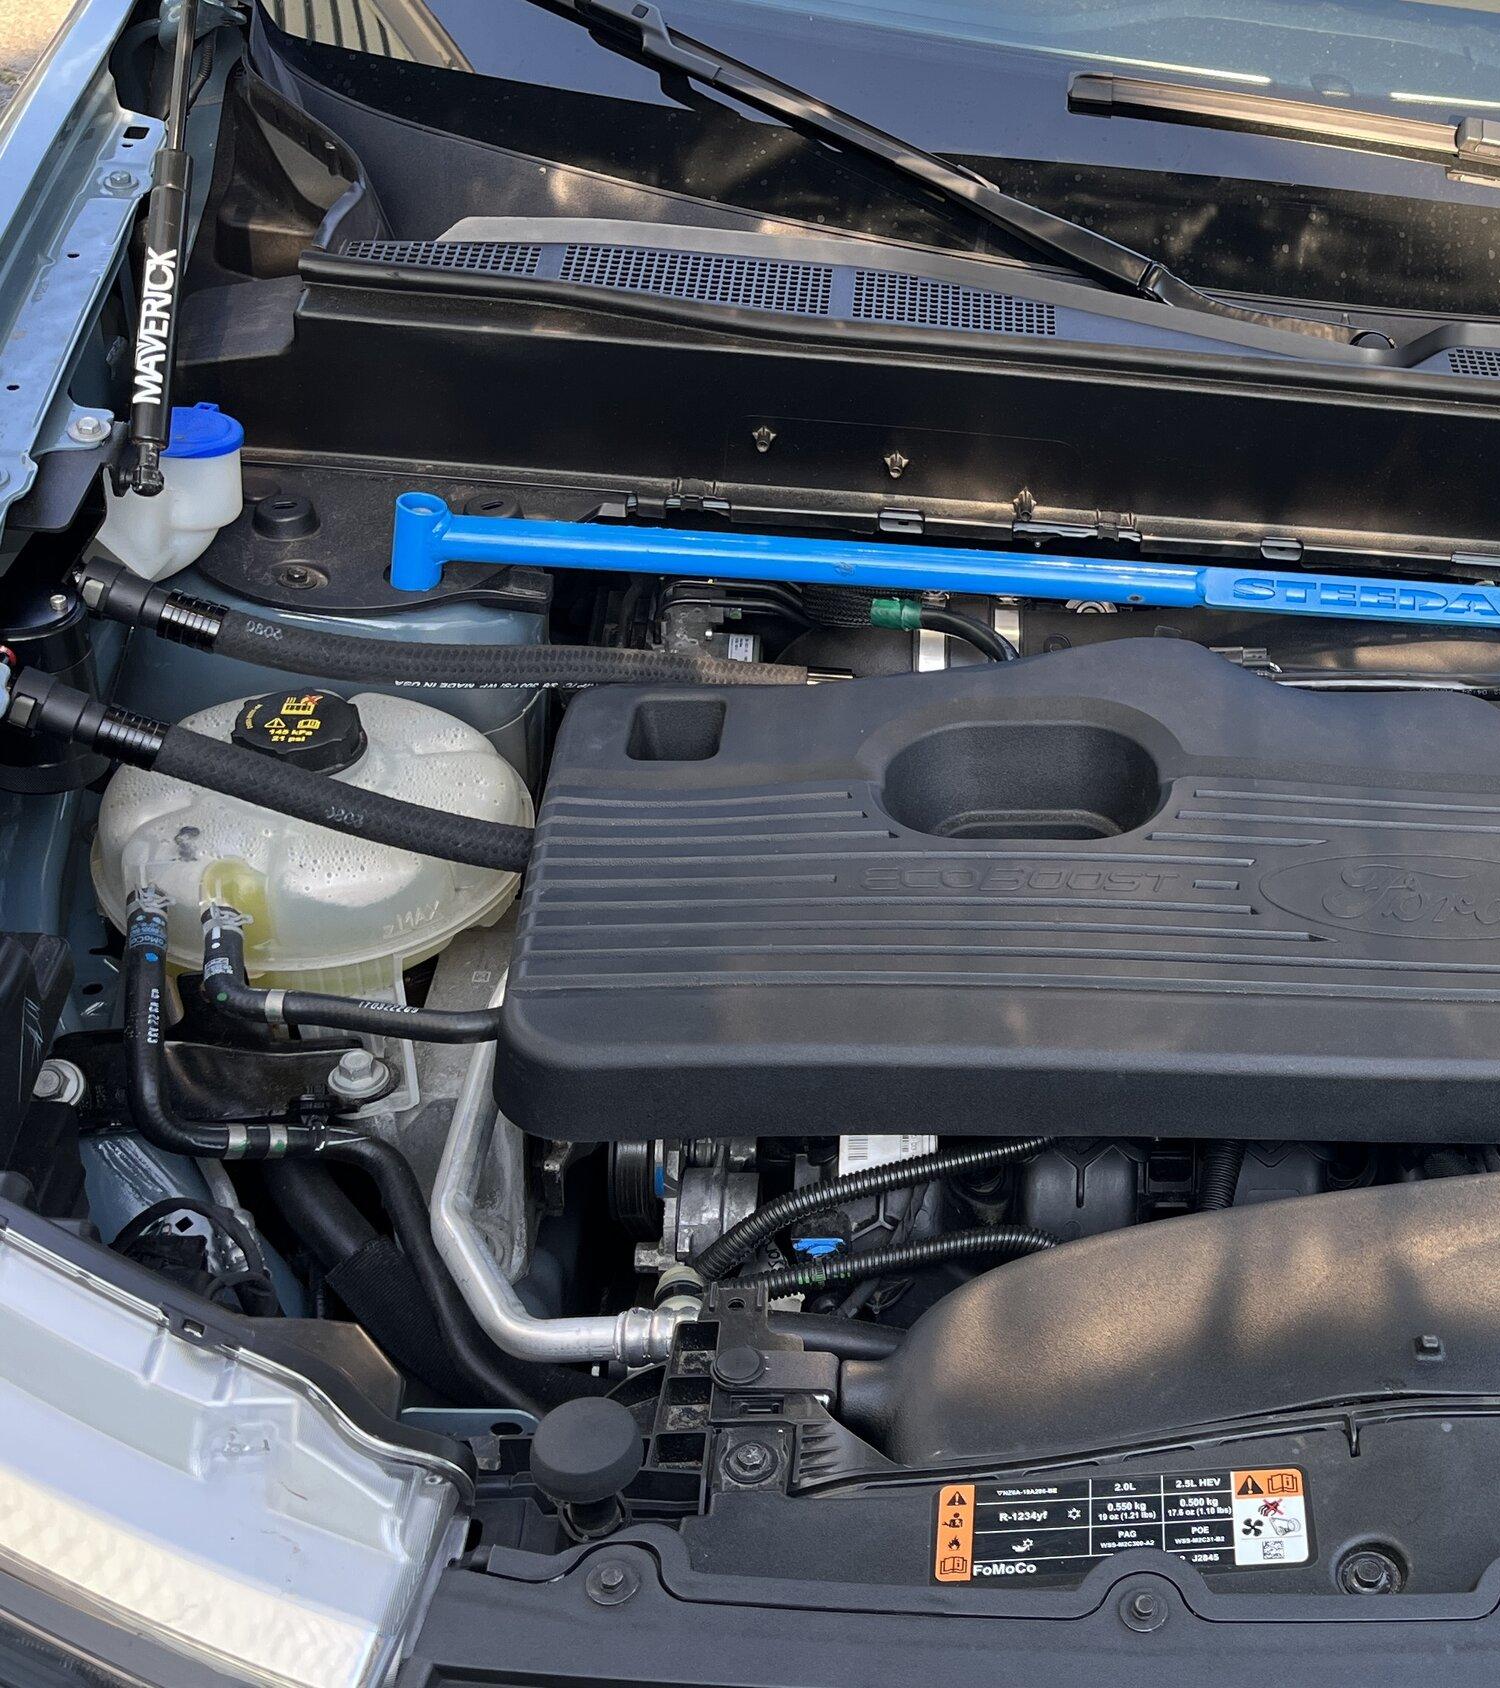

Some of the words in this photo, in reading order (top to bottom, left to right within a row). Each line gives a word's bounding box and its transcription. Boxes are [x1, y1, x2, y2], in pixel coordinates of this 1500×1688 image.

[132, 246, 177, 404] MAVERICK
[1233, 577, 1500, 616] STEEDA
[394, 680, 421, 688] USA
[439, 681, 475, 689] MADE
[1114, 1482, 1136, 1492] 2.0L
[1175, 1479, 1197, 1489] 2.5L
[1199, 1478, 1221, 1487] HEV
[1107, 1502, 1132, 1511] 0.550
[1135, 1501, 1147, 1512] kg
[1179, 1498, 1204, 1508] 0.500
[1206, 1497, 1219, 1507] kg
[999, 1510, 1048, 1522] R-1234yf
[1098, 1513, 1108, 1521] 19
[1120, 1511, 1139, 1521] (1.21
[1140, 1510, 1157, 1519] lbs)
[1216, 1506, 1232, 1515] lbs)
[1117, 1530, 1137, 1539] PAG
[1191, 1526, 1210, 1535] POE
[1191, 1554, 1220, 1563] J2845
[973, 1562, 1037, 1577] FoMoCo
